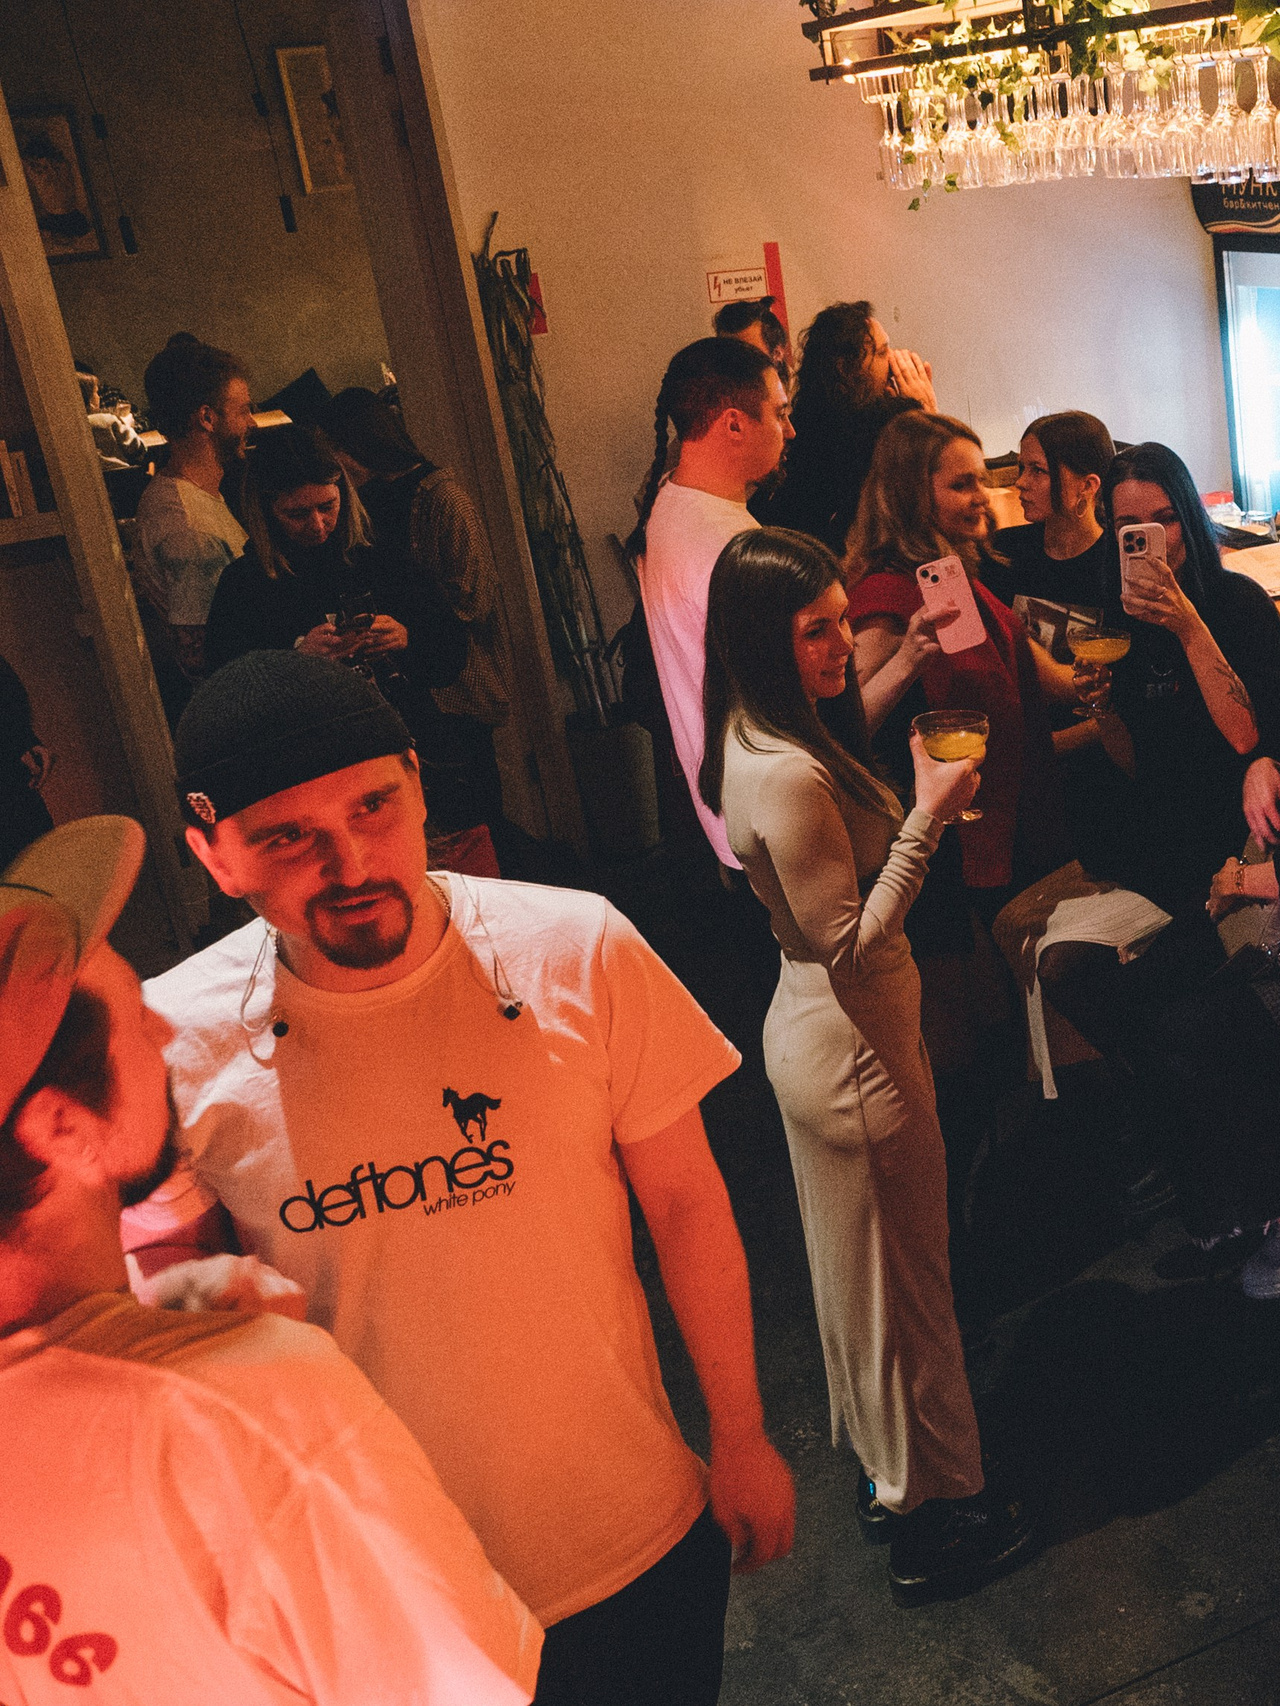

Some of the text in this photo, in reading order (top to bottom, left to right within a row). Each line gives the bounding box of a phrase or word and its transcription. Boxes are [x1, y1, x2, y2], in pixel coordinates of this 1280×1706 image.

[734, 275, 762, 284] ВЛЕЗАЙ
[279, 1139, 514, 1233] deftones
[422, 1180, 517, 1217] white pony
